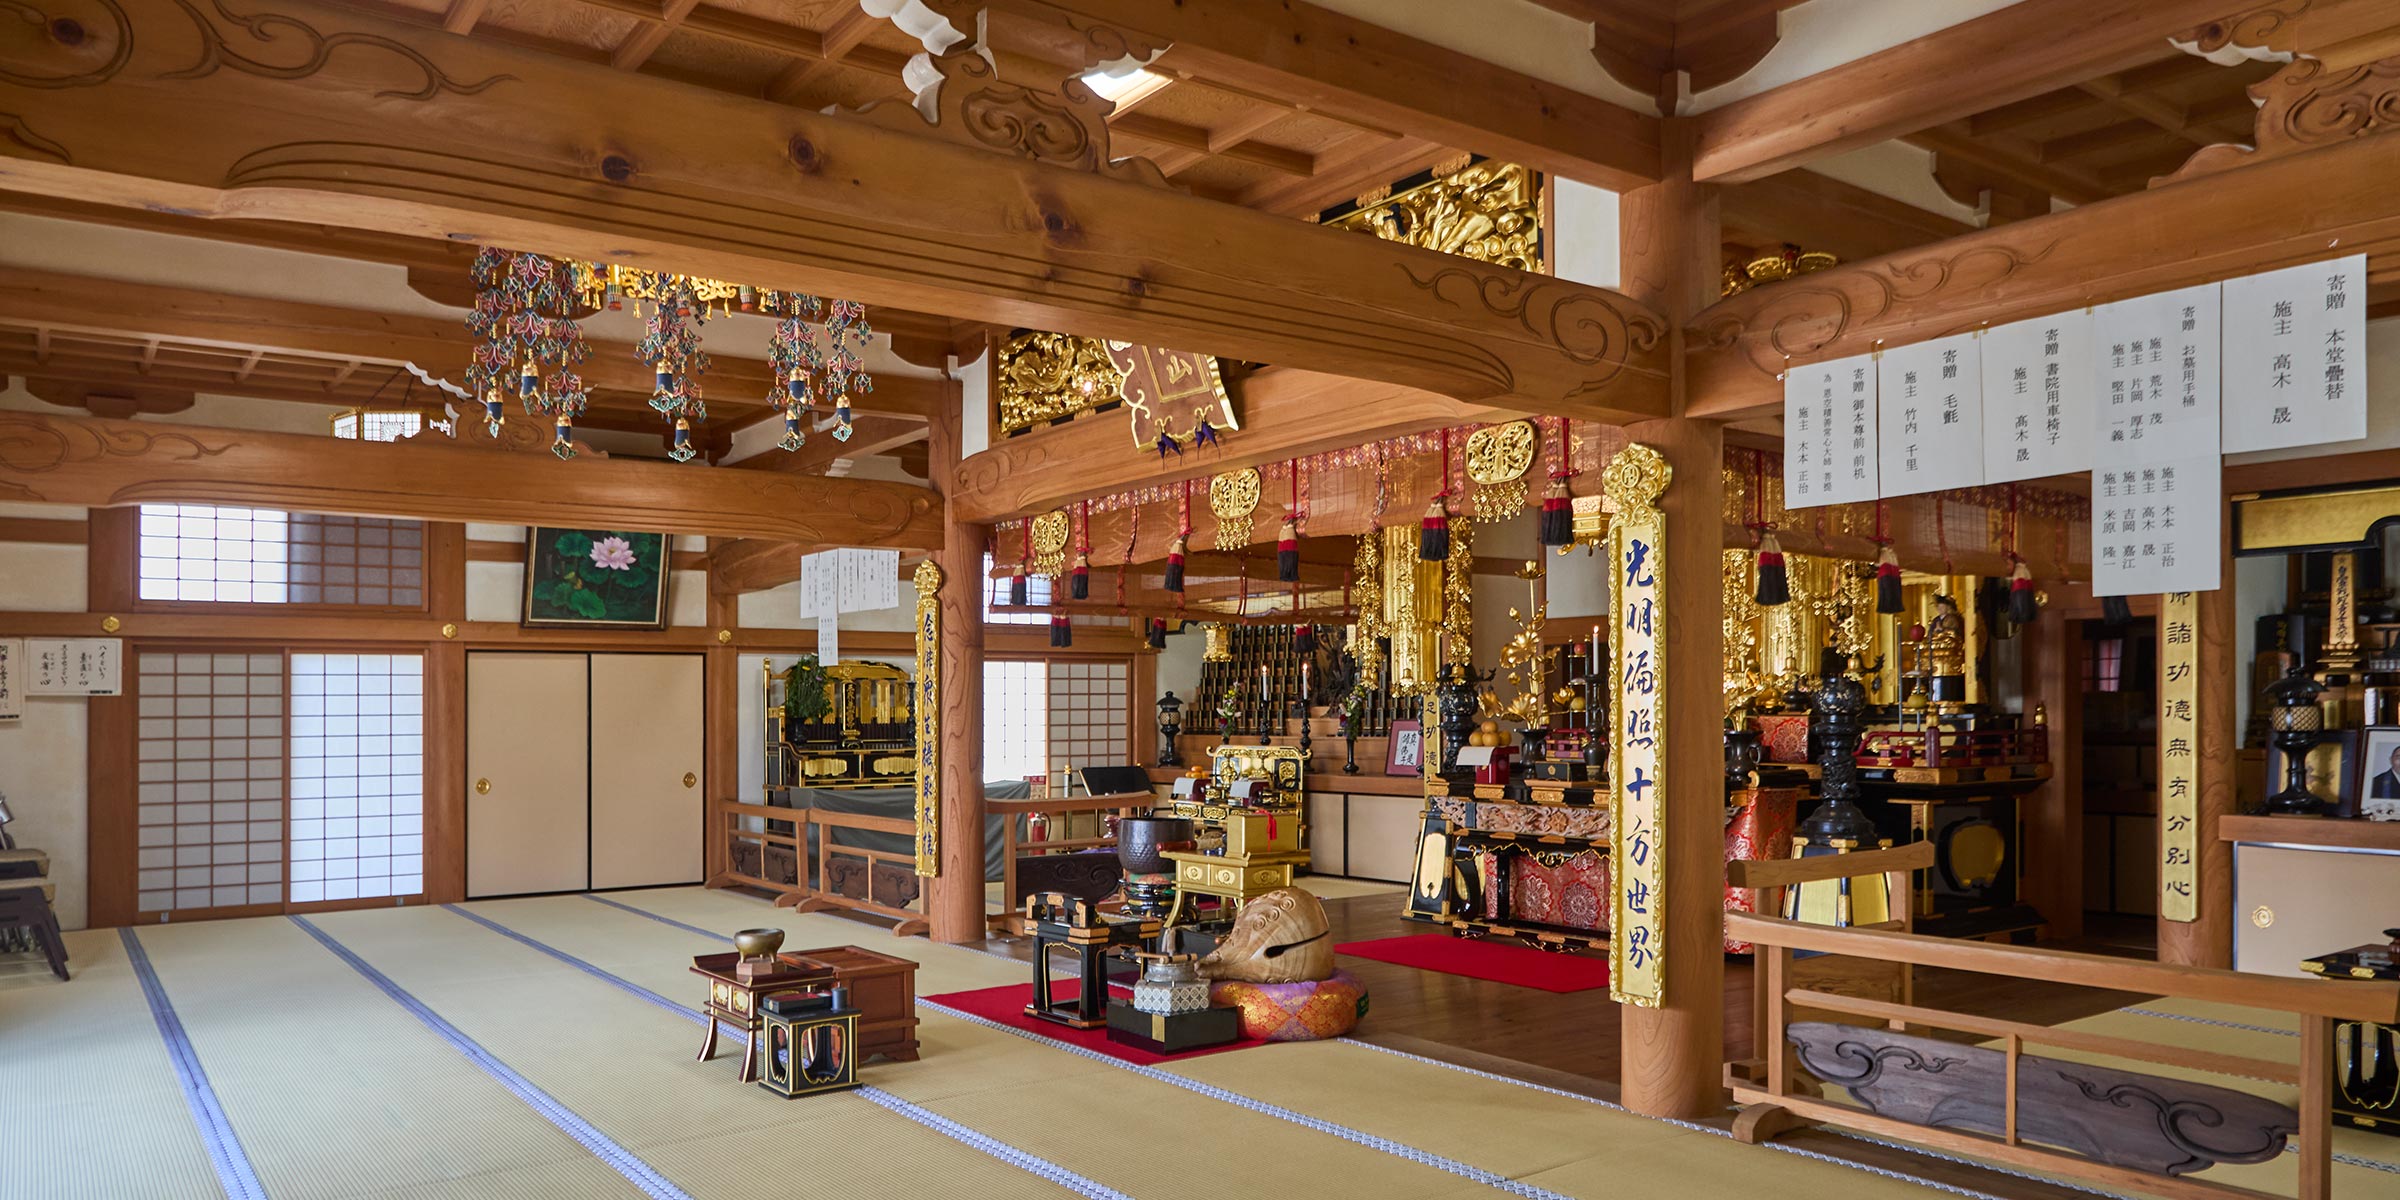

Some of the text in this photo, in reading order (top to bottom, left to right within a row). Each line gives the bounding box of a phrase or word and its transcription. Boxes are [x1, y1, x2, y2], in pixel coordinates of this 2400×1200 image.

[2325, 275, 2345, 311] 寄贈
[2182, 306, 2195, 331] 寄贈
[2273, 301, 2292, 335] 施主
[1943, 350, 1957, 379] 寄贈
[2112, 344, 2124, 368] 施主
[2131, 341, 2143, 365] 施主
[1824, 374, 1831, 382] 為
[1853, 368, 1864, 393] 寄贈
[2014, 367, 2027, 394] 施主
[2045, 329, 2060, 445] 寄贈 書院用車椅子
[2131, 378, 2142, 402] 片岡
[2149, 338, 2162, 424] 施主 荒木 茂
[1905, 371, 1918, 471] 施主 竹内 千里
[1799, 407, 1808, 494] 施主 木本 正治
[2103, 473, 2116, 496] 施主
[2123, 471, 2135, 495] 施主
[2143, 469, 2155, 493] 施主
[2103, 510, 2115, 533] 米原
[2123, 509, 2135, 532] 吉岡
[2162, 467, 2174, 567] 施主 木本 正治
